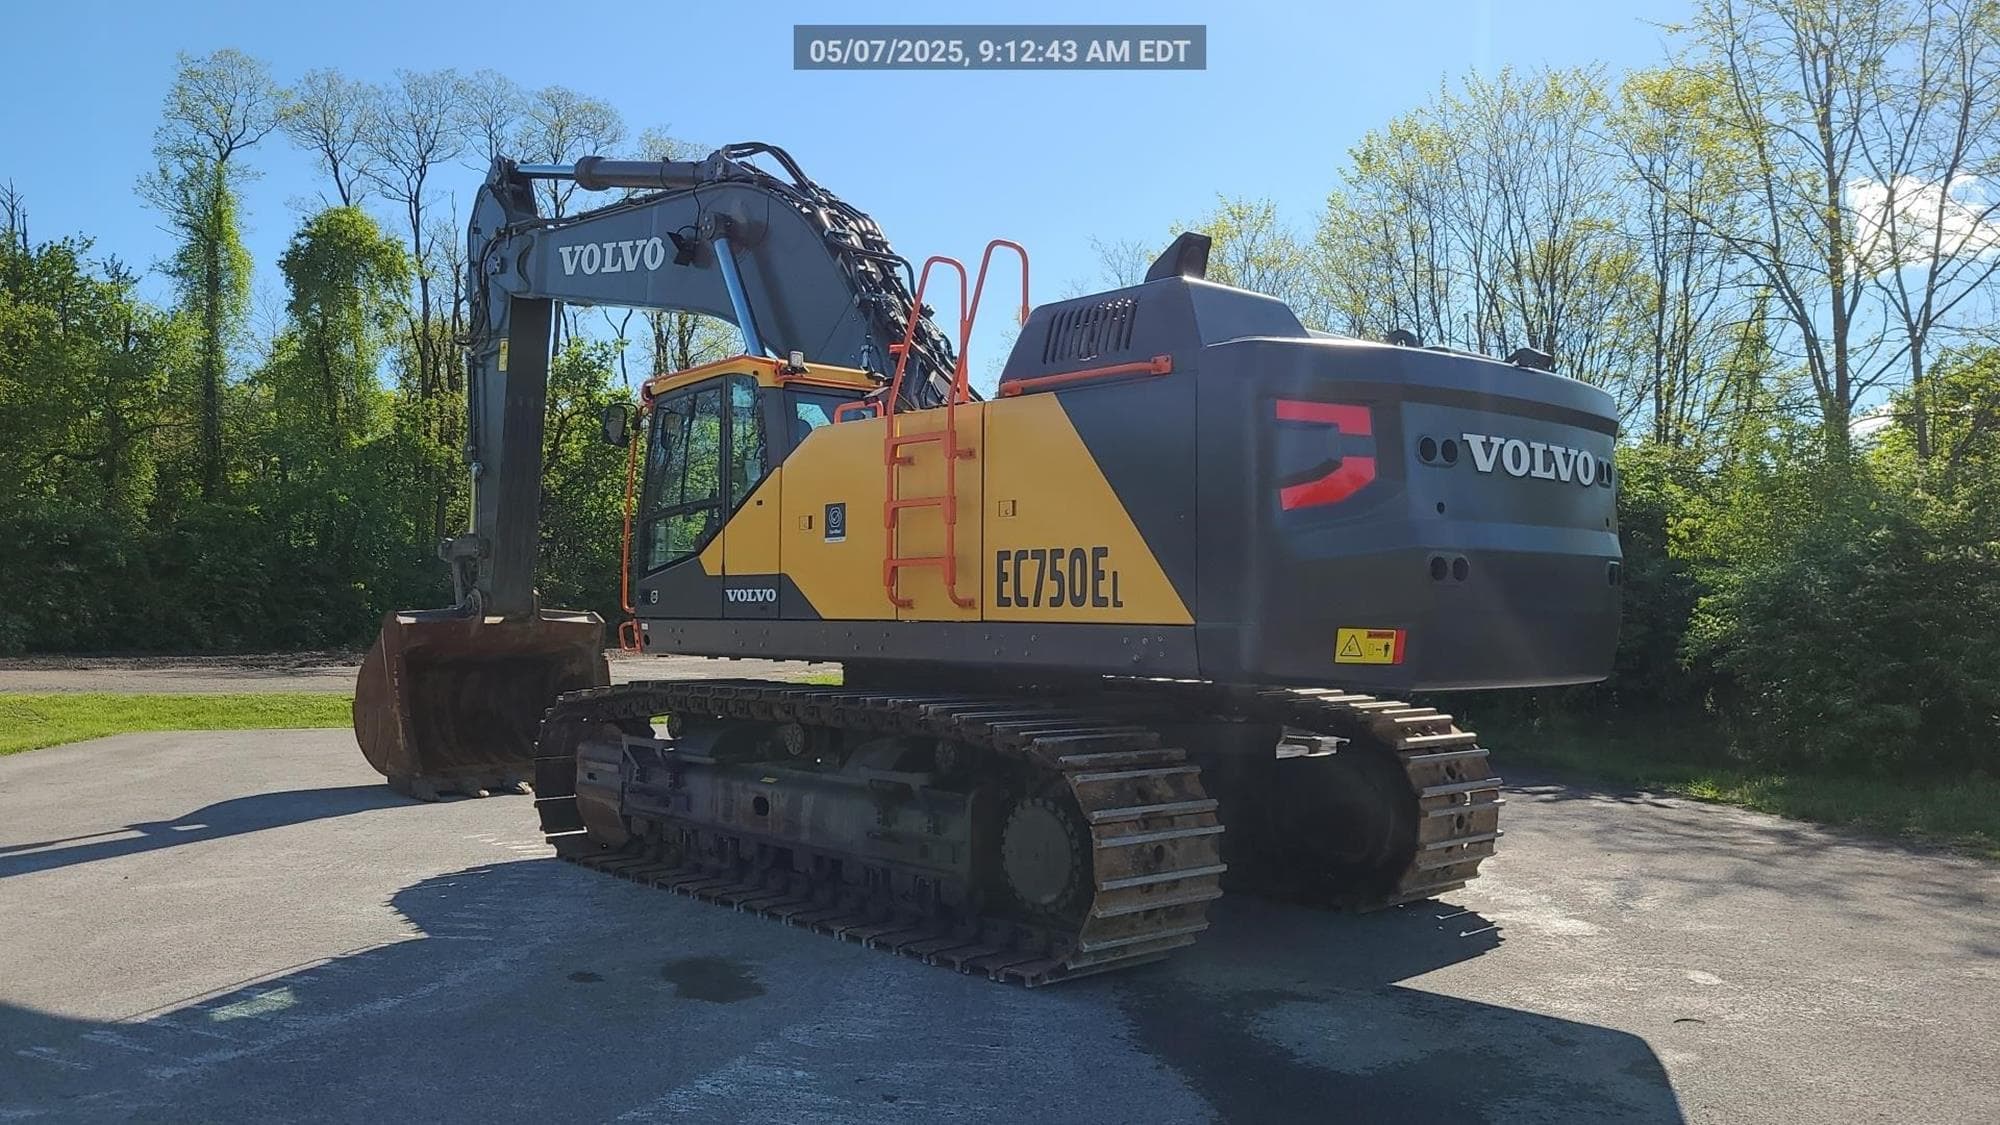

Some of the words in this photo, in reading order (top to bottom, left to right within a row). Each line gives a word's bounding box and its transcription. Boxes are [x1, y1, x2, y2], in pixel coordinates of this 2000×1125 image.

[558, 236, 665, 276] VOLVO
[1462, 433, 1596, 486] VOLVO
[725, 588, 777, 602] VOLVO
